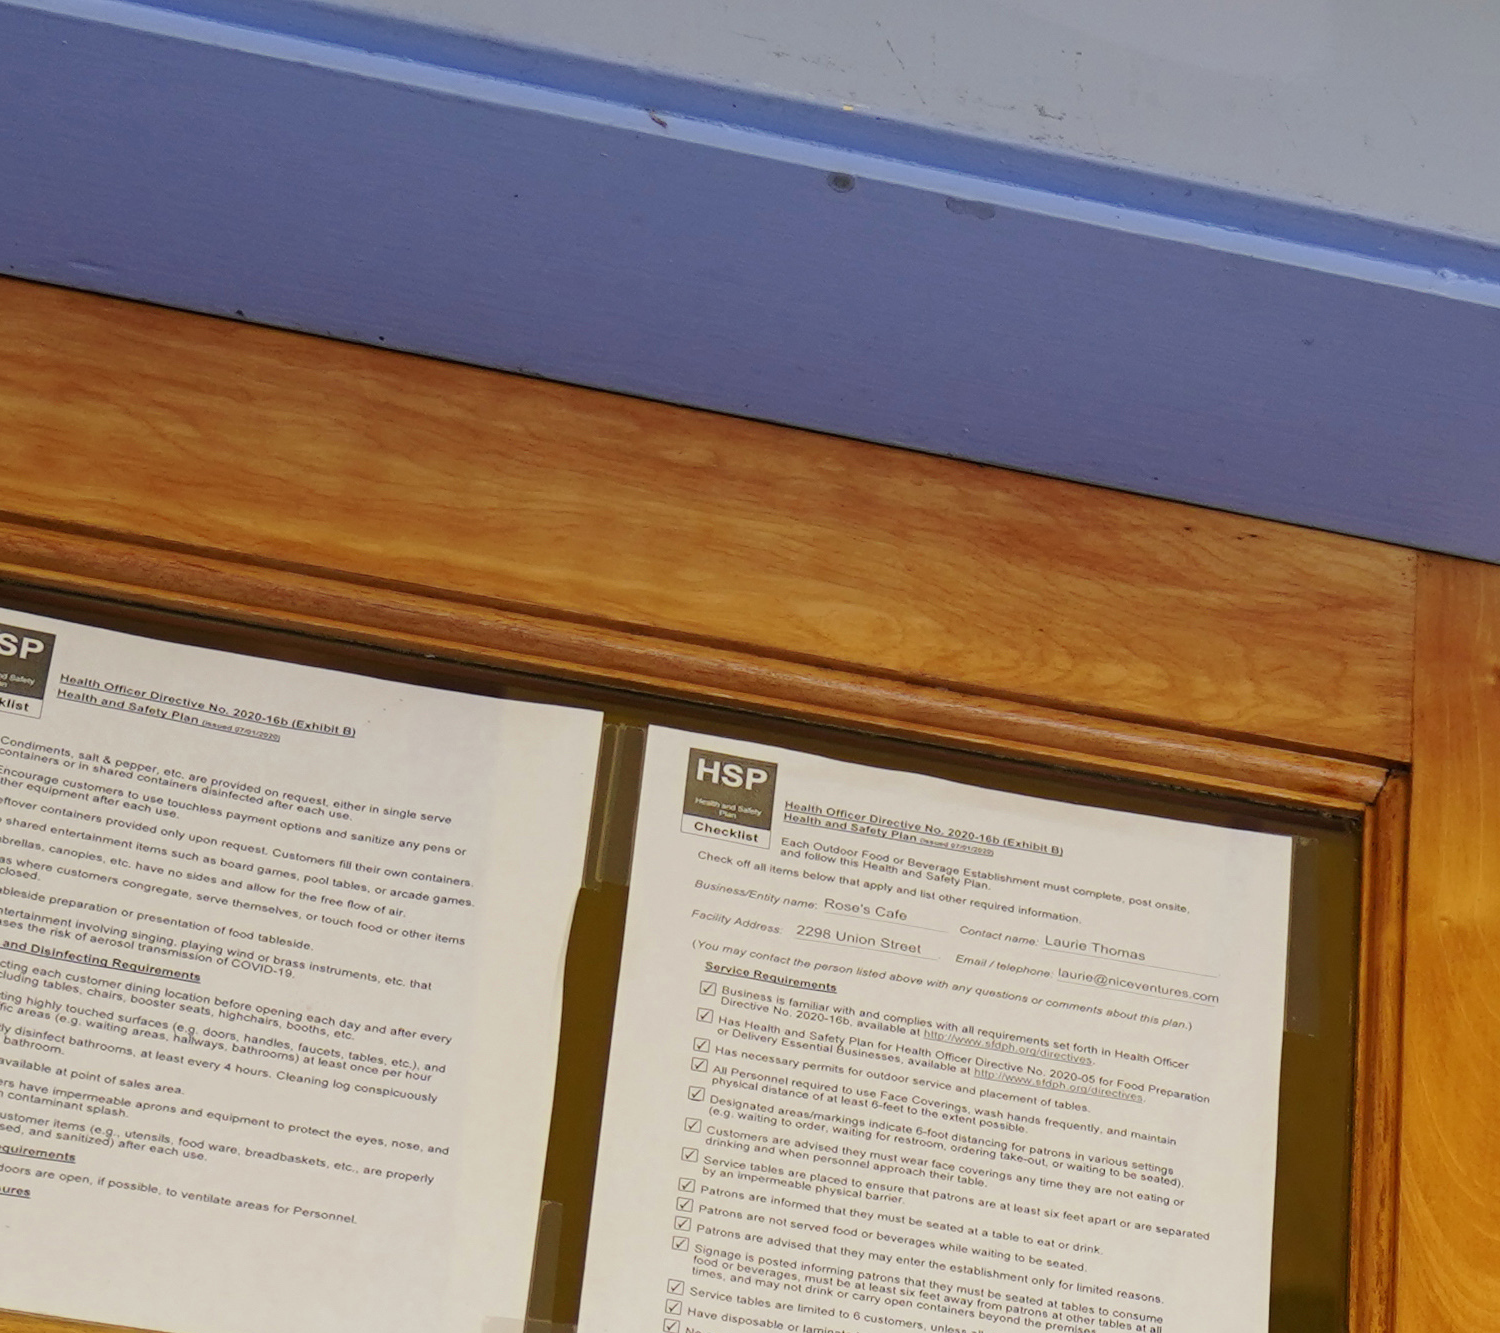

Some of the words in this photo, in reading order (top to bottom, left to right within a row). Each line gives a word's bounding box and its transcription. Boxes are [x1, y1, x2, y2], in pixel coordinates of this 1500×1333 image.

[60, 673, 100, 690] Health
[104, 682, 147, 699] Officer
[150, 690, 205, 710] Directive
[209, 702, 229, 715] No.
[232, 707, 289, 727] 2020-16b
[291, 718, 340, 735] (Exhibit
[342, 724, 357, 738] B)
[695, 757, 769, 791] HSP
[693, 820, 759, 843] Checklist
[823, 897, 871, 916] Rose's
[874, 905, 908, 922] Cafe
[795, 924, 832, 940] 2298
[835, 930, 877, 947] Union
[879, 936, 922, 955] Street
[1044, 934, 1088, 952] Laurie
[1091, 941, 1146, 962] Thomas
[705, 961, 750, 977] Service
[753, 970, 837, 992] Requirements
[1057, 967, 1220, 1004] laurie@niceventures.com
